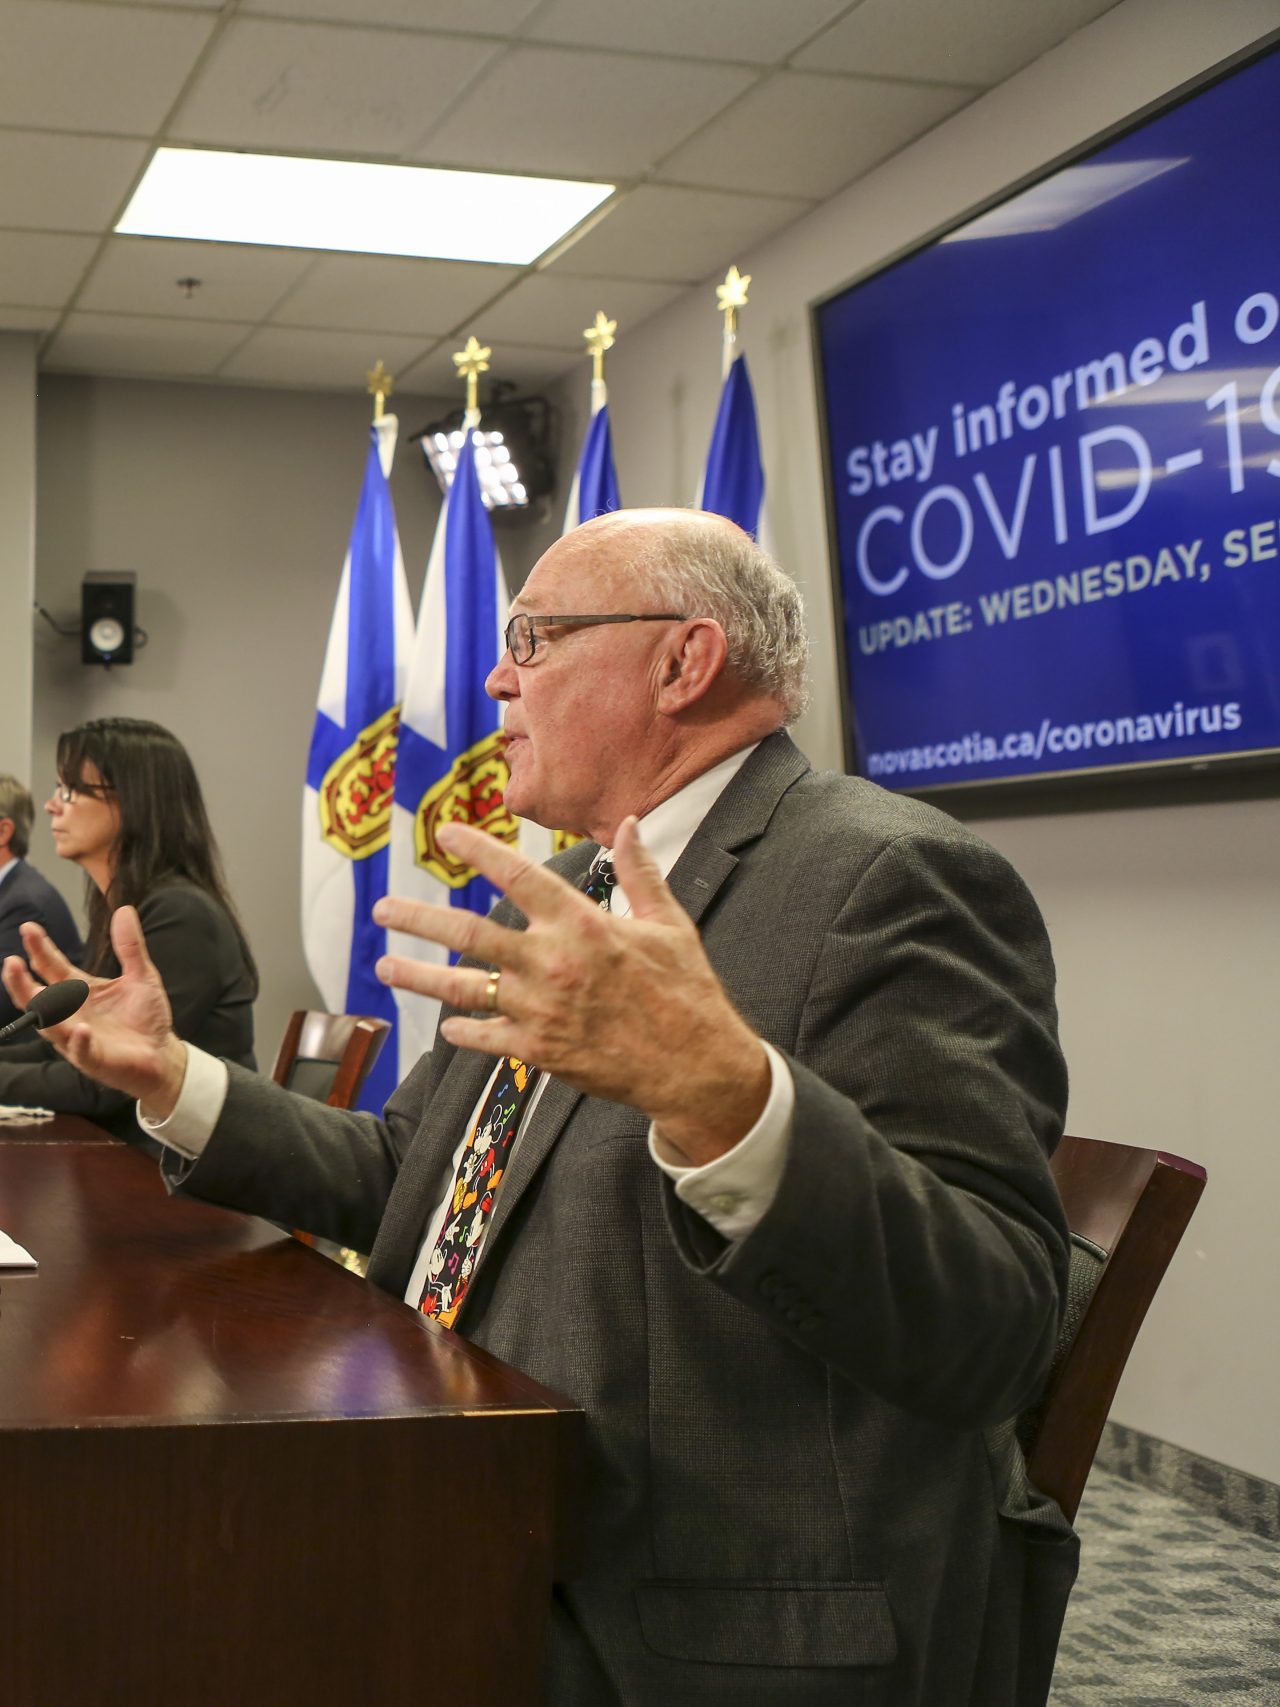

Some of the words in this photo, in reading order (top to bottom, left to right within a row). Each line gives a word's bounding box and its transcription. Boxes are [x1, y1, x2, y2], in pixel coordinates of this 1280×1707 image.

[847, 425, 939, 496] Stay
[951, 299, 1210, 458] informed
[858, 602, 973, 656] UPDATE:
[978, 538, 1211, 627] WEDNESDAY,
[1222, 519, 1280, 568] SE
[867, 701, 1242, 777] novascotia.ca/coronavirus
